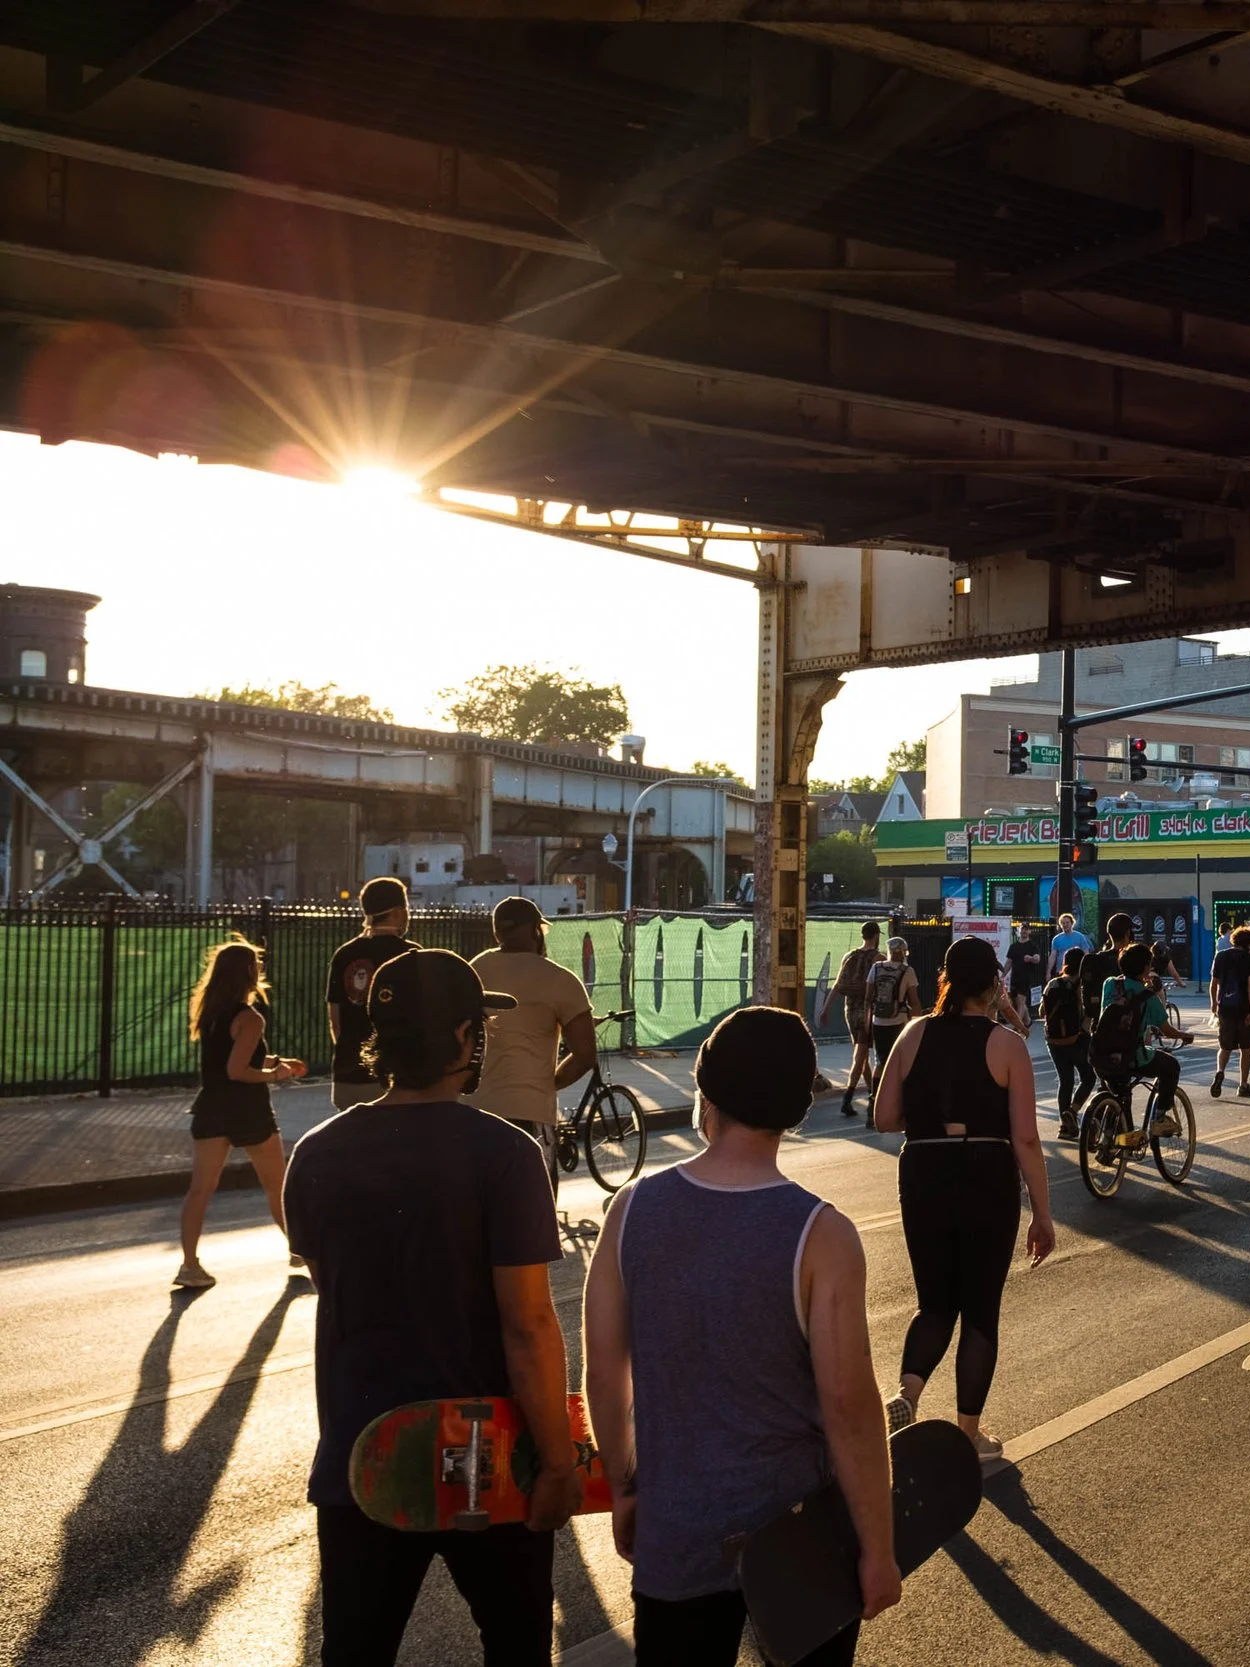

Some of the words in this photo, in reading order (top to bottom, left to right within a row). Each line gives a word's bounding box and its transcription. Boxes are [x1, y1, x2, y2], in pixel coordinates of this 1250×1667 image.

[1041, 747, 1059, 756] Clark
[1114, 814, 1149, 840] Grill
[1159, 813, 1192, 835] 3404
